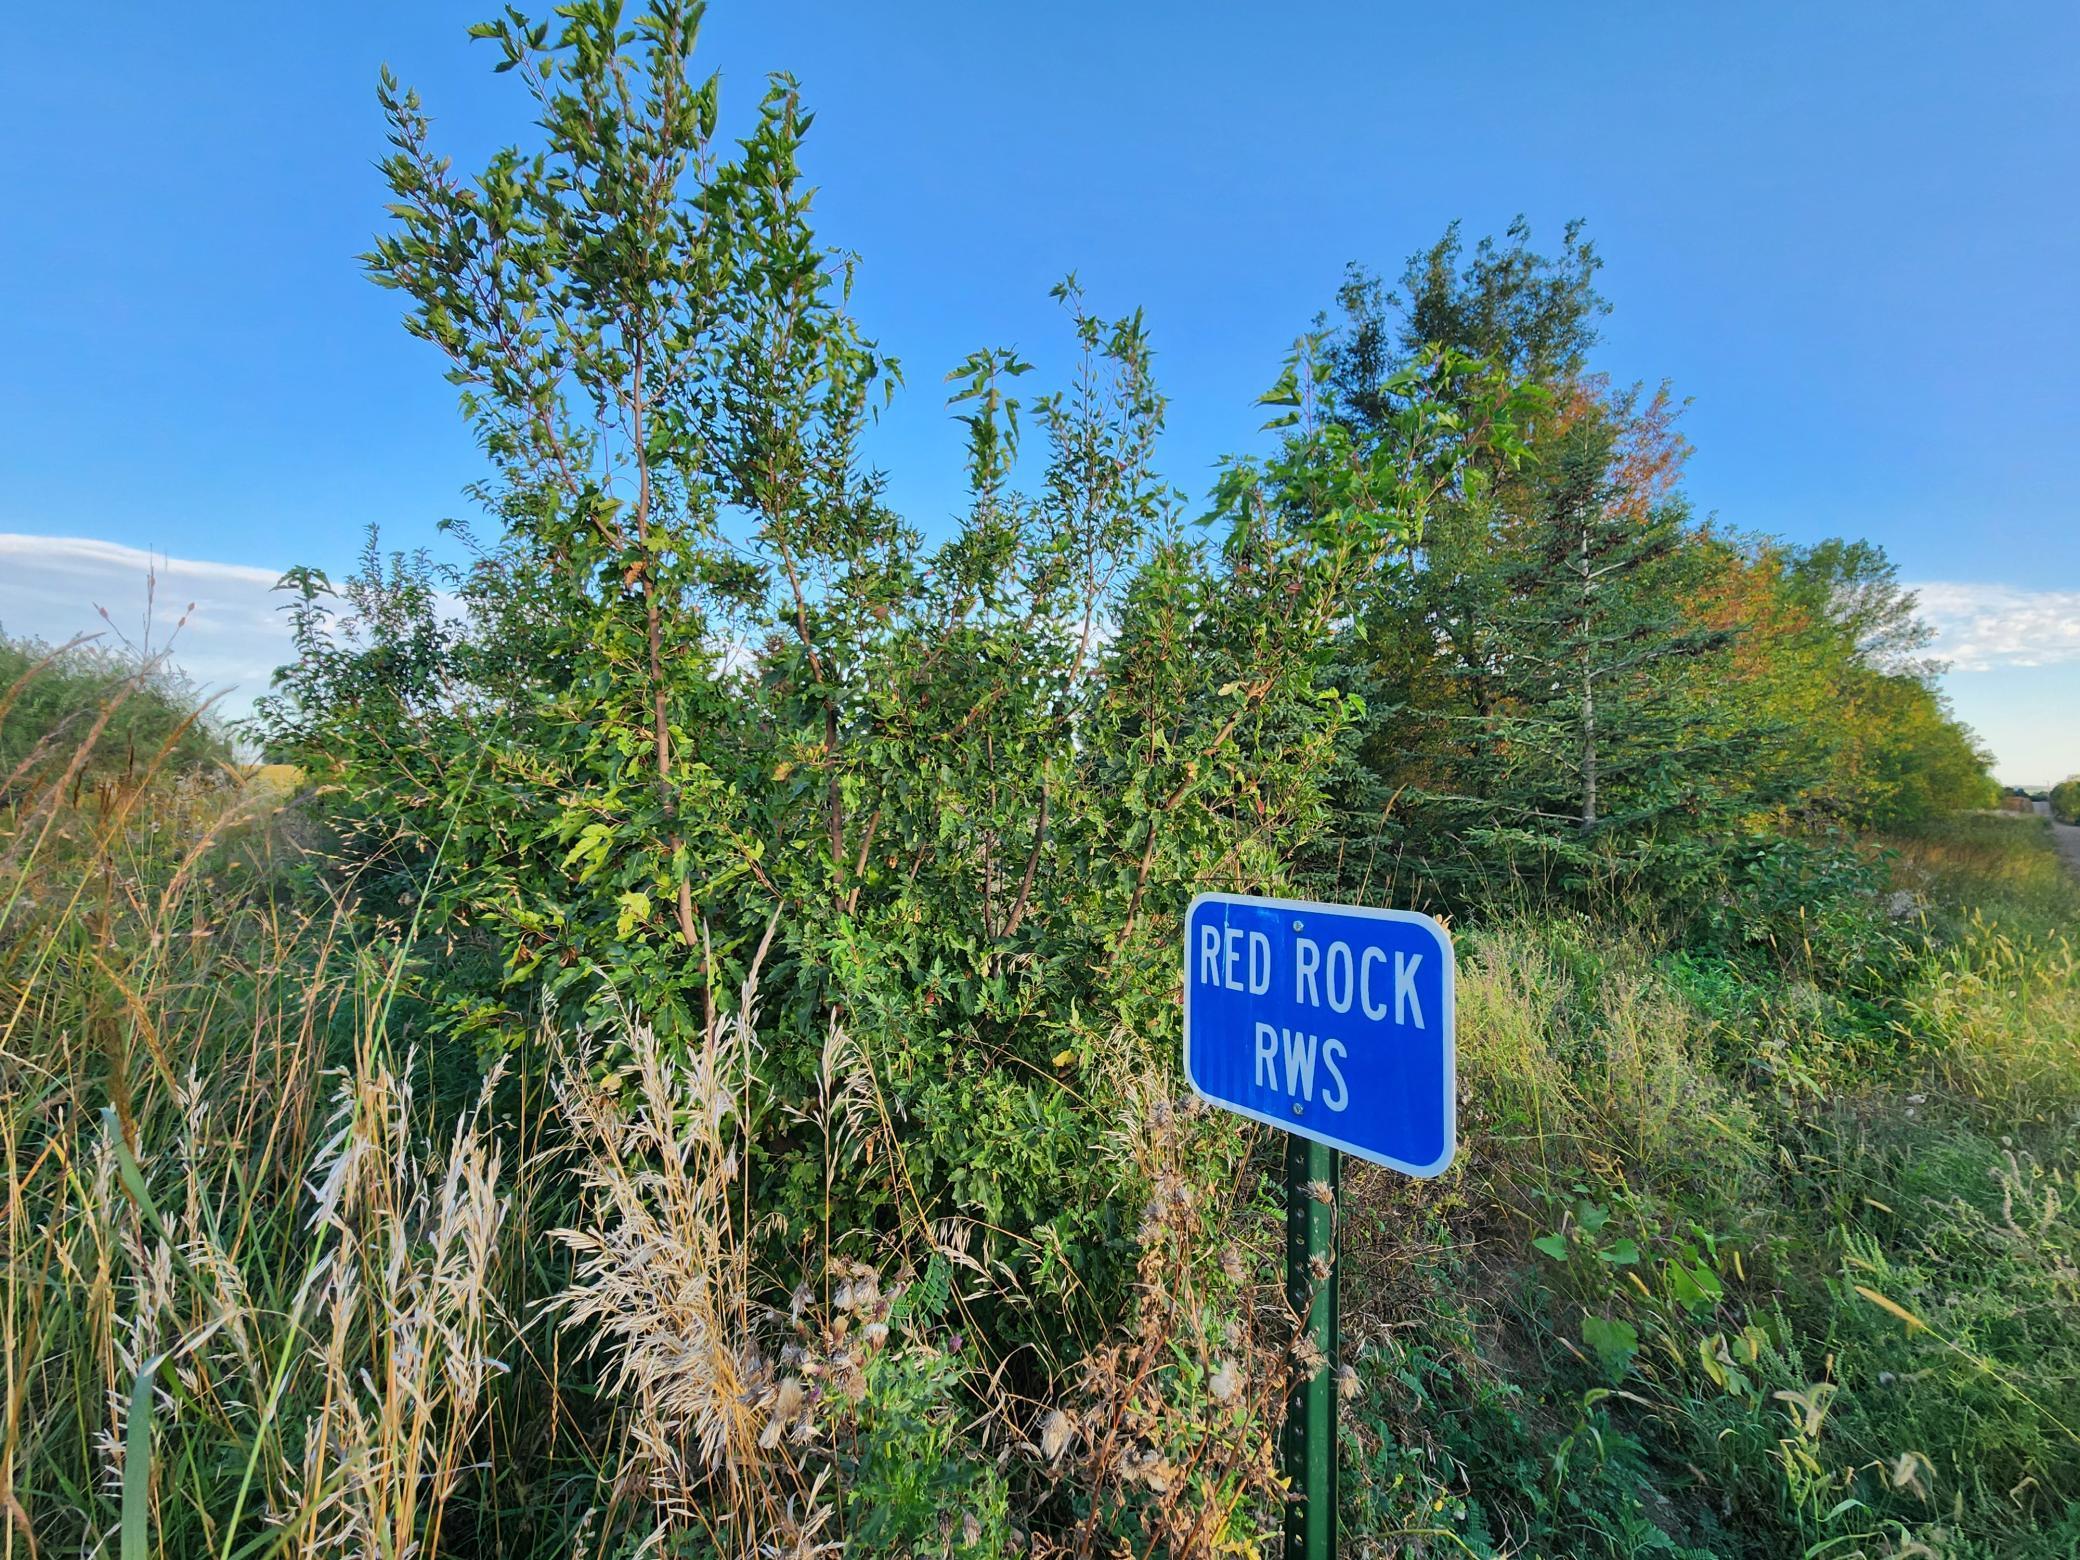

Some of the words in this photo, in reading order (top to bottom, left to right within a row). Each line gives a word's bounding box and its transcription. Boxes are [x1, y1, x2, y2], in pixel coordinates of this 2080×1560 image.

[1201, 924, 1271, 996] RED
[1296, 938, 1425, 1030] ROCK
[1255, 1022, 1349, 1113] RWS
